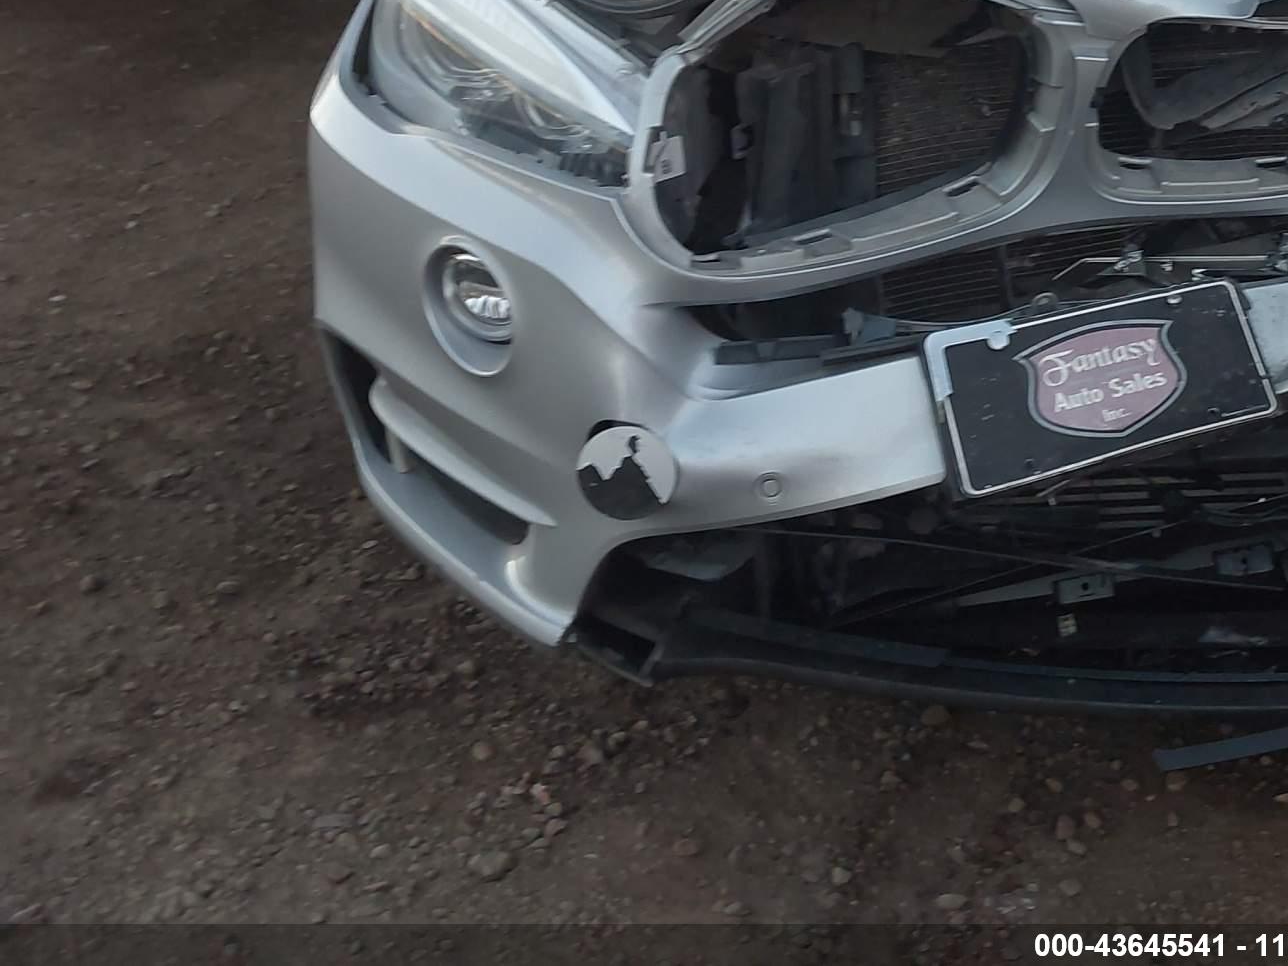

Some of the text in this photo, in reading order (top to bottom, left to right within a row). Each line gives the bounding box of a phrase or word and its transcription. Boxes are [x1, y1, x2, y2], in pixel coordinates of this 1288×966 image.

[1041, 338, 1160, 386] Fantasy
[1054, 371, 1167, 412] Auto Sales
[1103, 407, 1130, 422] Inc.
